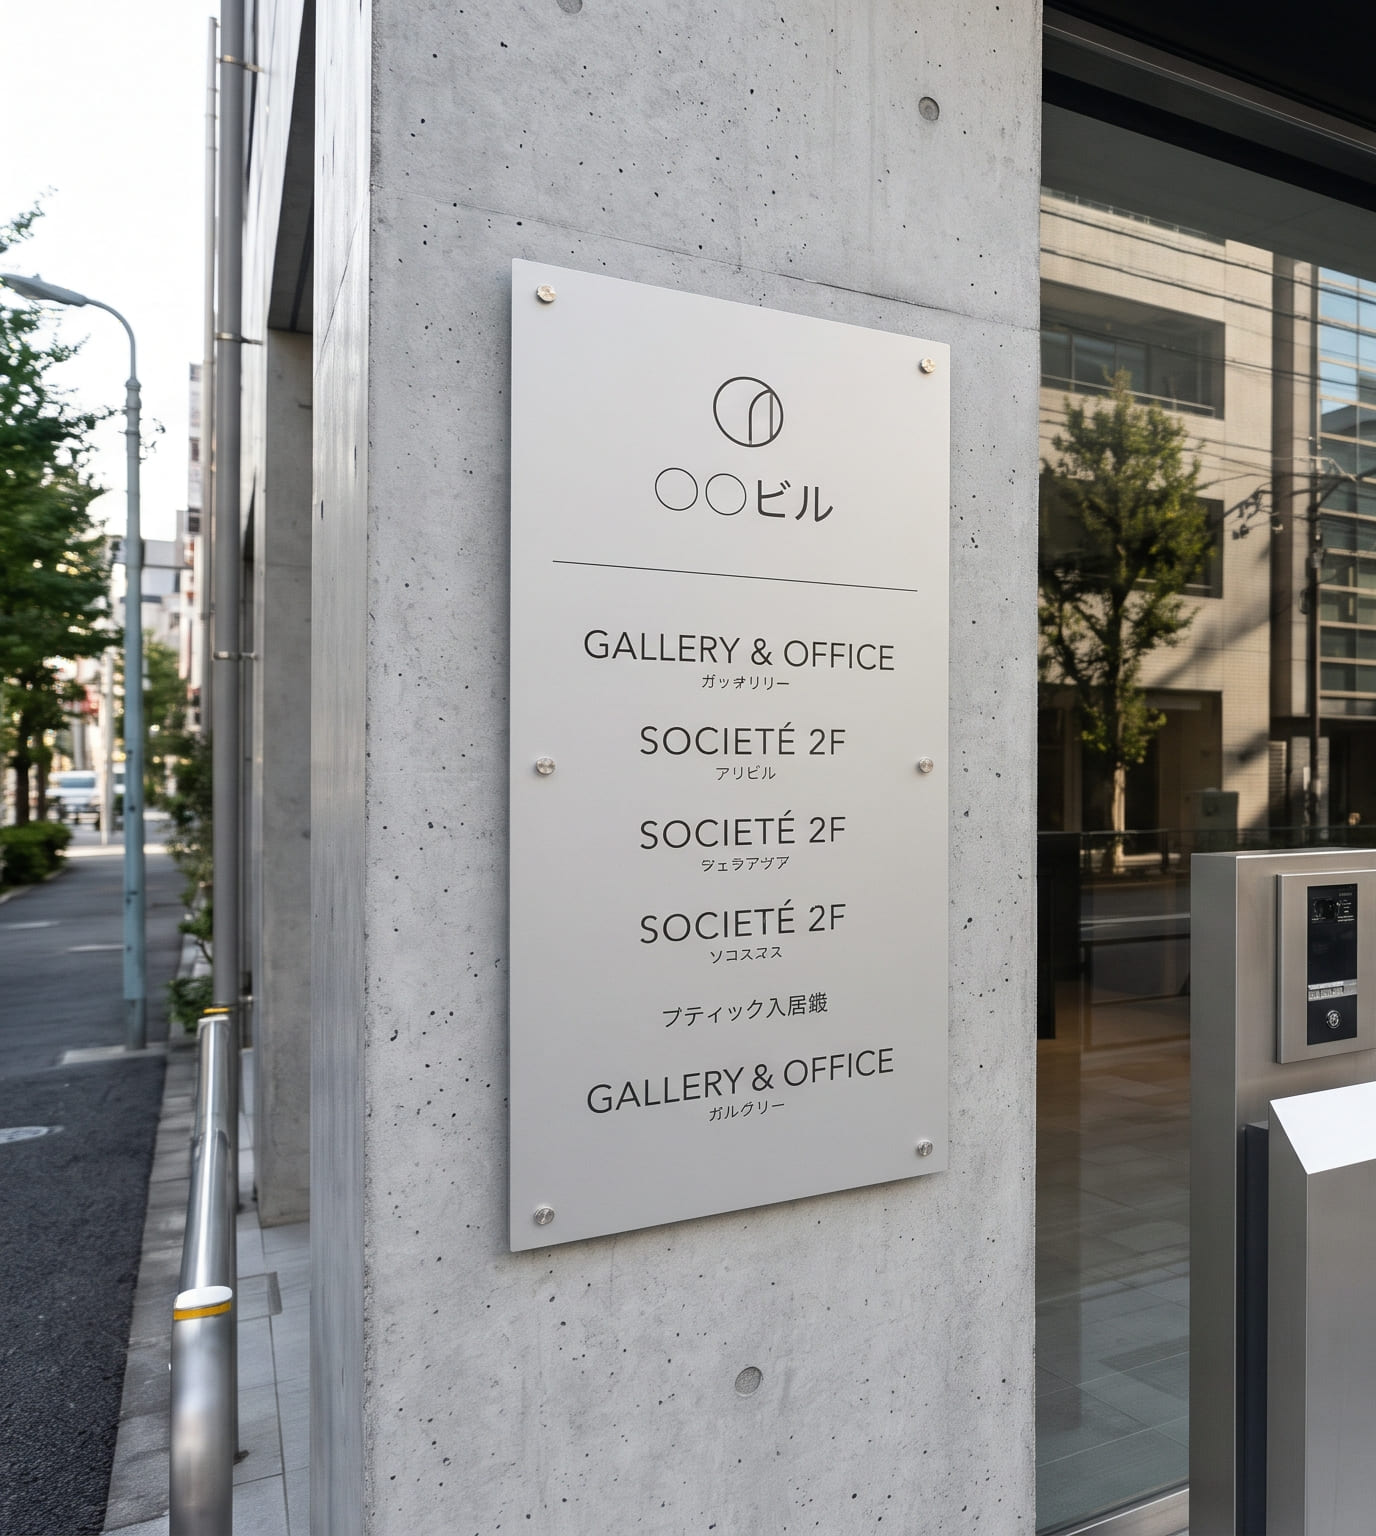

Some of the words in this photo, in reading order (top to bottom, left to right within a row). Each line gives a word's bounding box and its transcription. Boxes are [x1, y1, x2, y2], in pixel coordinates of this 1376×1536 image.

[583, 629, 741, 665] GALLERY
[750, 637, 774, 666] &
[783, 639, 895, 671] OFFICE
[639, 721, 796, 756] SOCIETÉ
[808, 728, 847, 756] 2F
[639, 809, 796, 850] SOCIETÉ
[808, 816, 847, 844] 2F
[639, 898, 796, 945] SOCIETÉ
[808, 903, 847, 933] 2F
[586, 1066, 745, 1114] GALLERY
[751, 1063, 775, 1092] &
[783, 1047, 894, 1087] OFFICE
